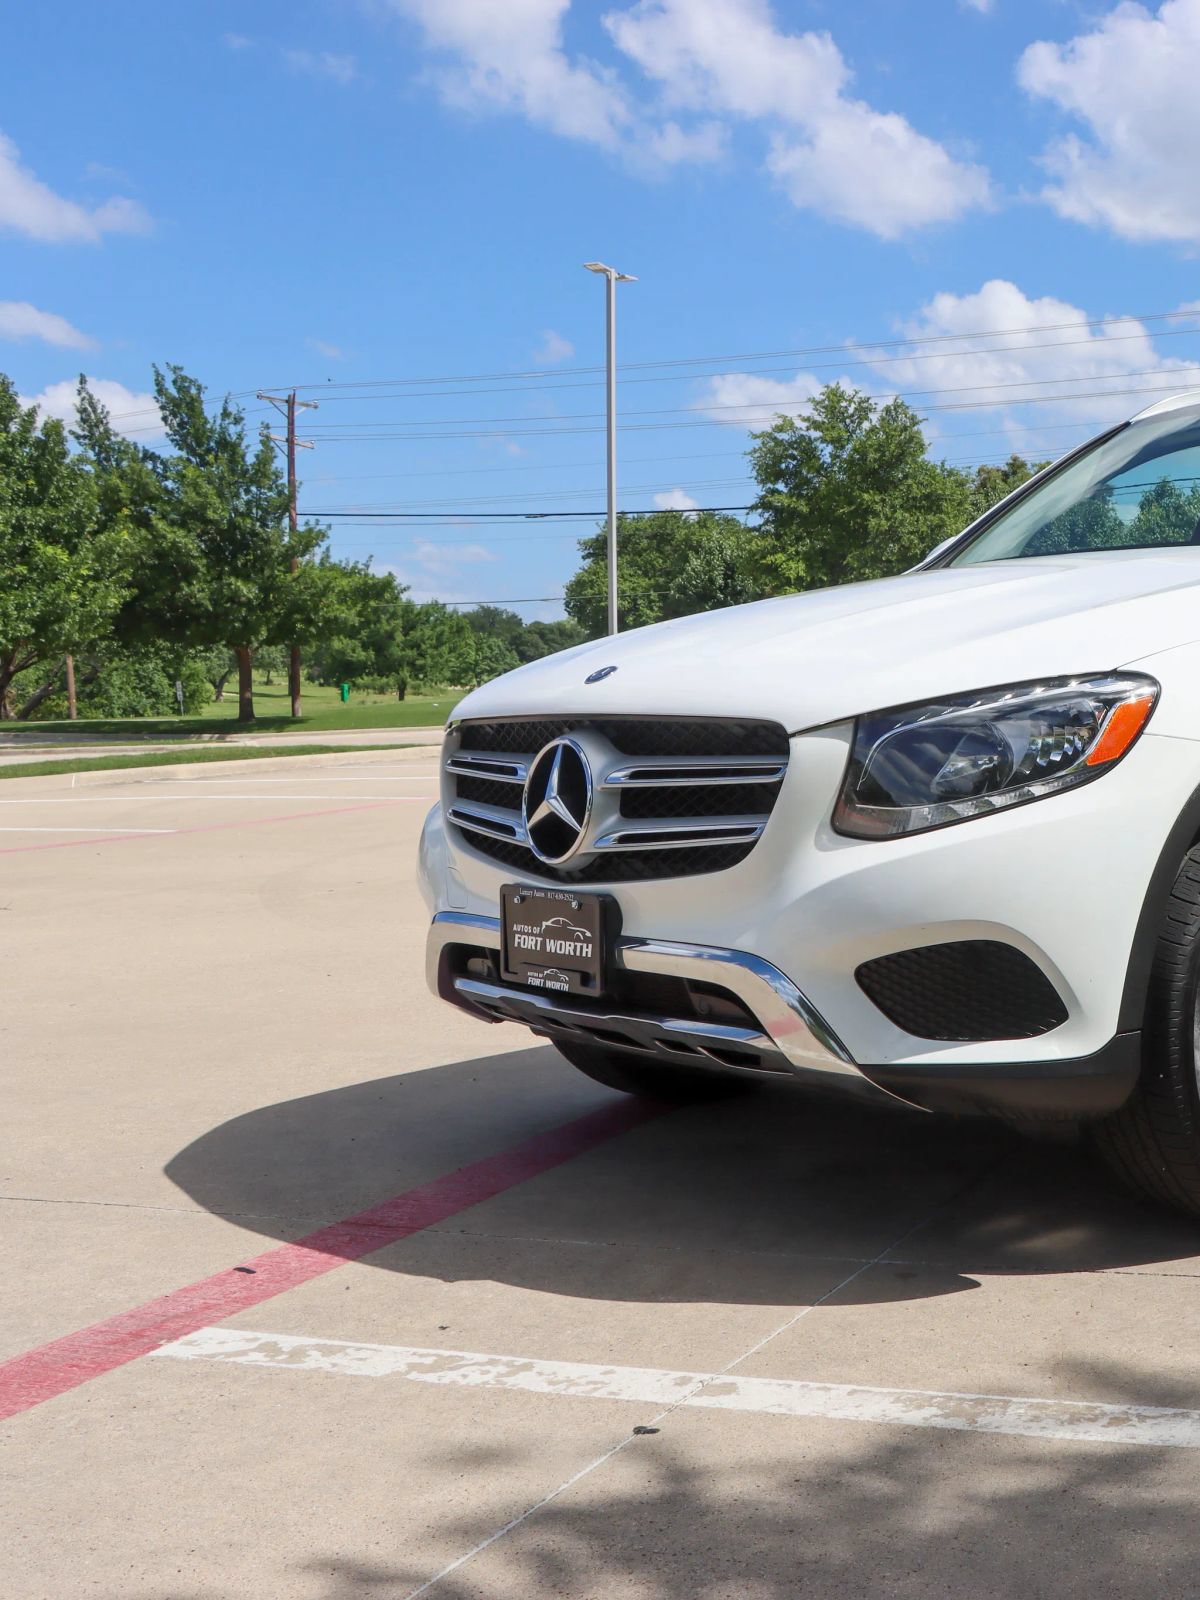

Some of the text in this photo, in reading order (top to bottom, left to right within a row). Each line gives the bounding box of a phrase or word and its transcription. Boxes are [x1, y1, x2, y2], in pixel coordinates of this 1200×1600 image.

[512, 923, 541, 935] AUTOS OF
[514, 933, 593, 958] FORT WORTH
[527, 977, 569, 992] FORT WORTH
